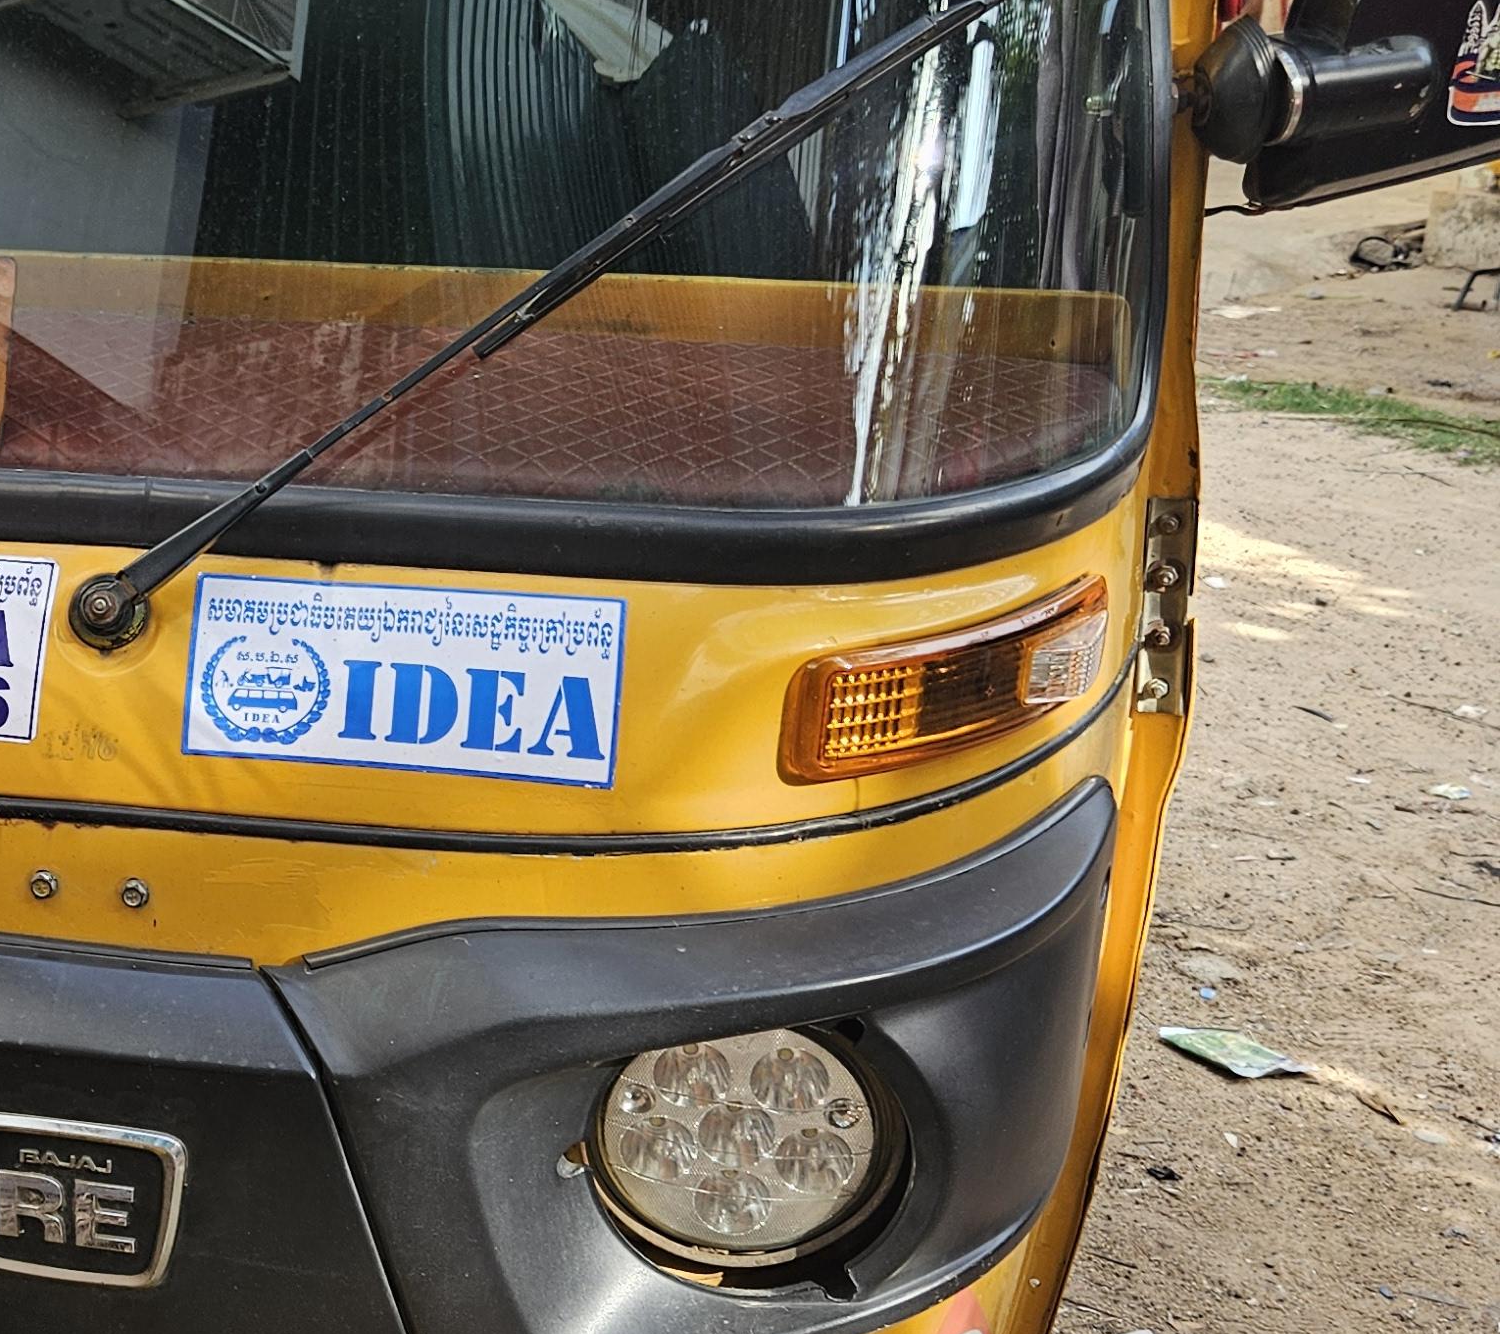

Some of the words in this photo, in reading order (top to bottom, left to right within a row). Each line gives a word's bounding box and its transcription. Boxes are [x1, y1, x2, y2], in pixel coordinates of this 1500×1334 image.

[243, 712, 281, 724] IDEA
[337, 659, 606, 761] IDEA
[19, 1148, 113, 1174] BAJAJ
